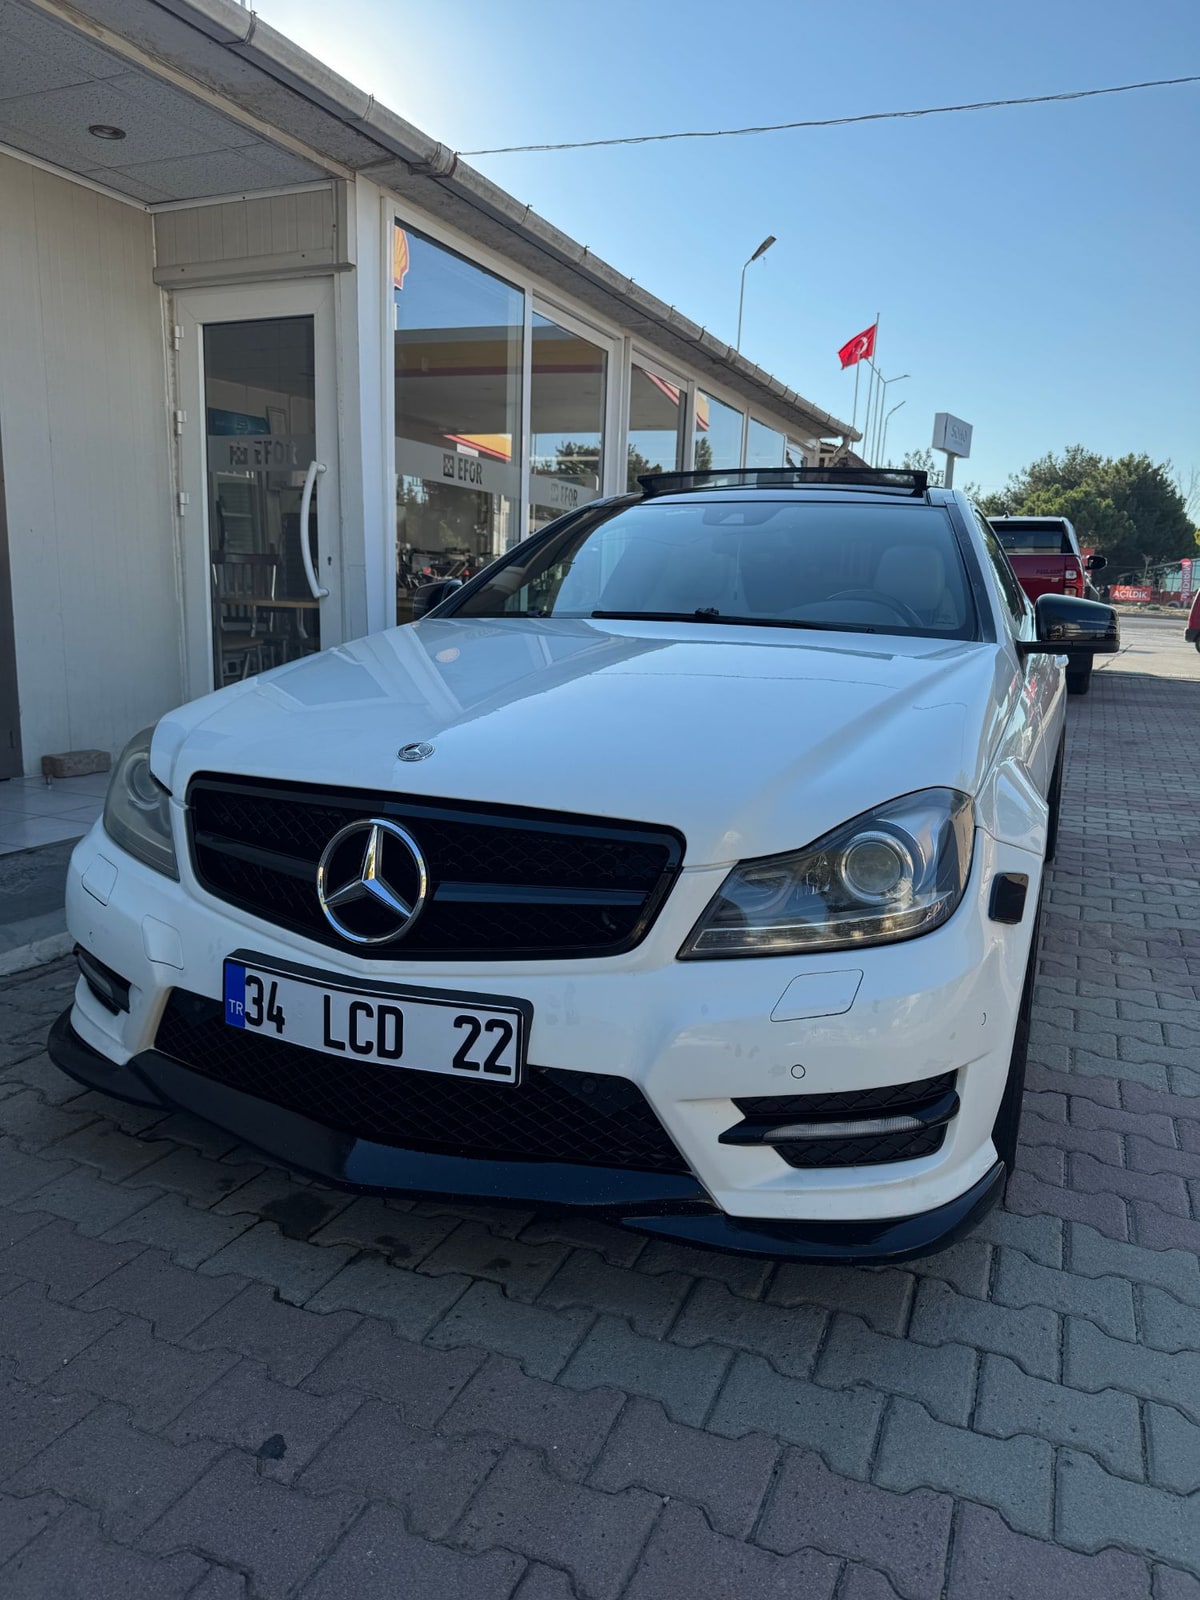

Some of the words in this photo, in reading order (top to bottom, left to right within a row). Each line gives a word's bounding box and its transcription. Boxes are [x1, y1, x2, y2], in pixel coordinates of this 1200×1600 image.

[254, 441, 298, 465] EFOR
[458, 458, 482, 485] EFOR
[560, 485, 578, 507] EFOR
[228, 999, 244, 1016] TR
[244, 975, 285, 1034] 34
[323, 994, 404, 1060] LCD
[452, 1014, 514, 1076] 22
